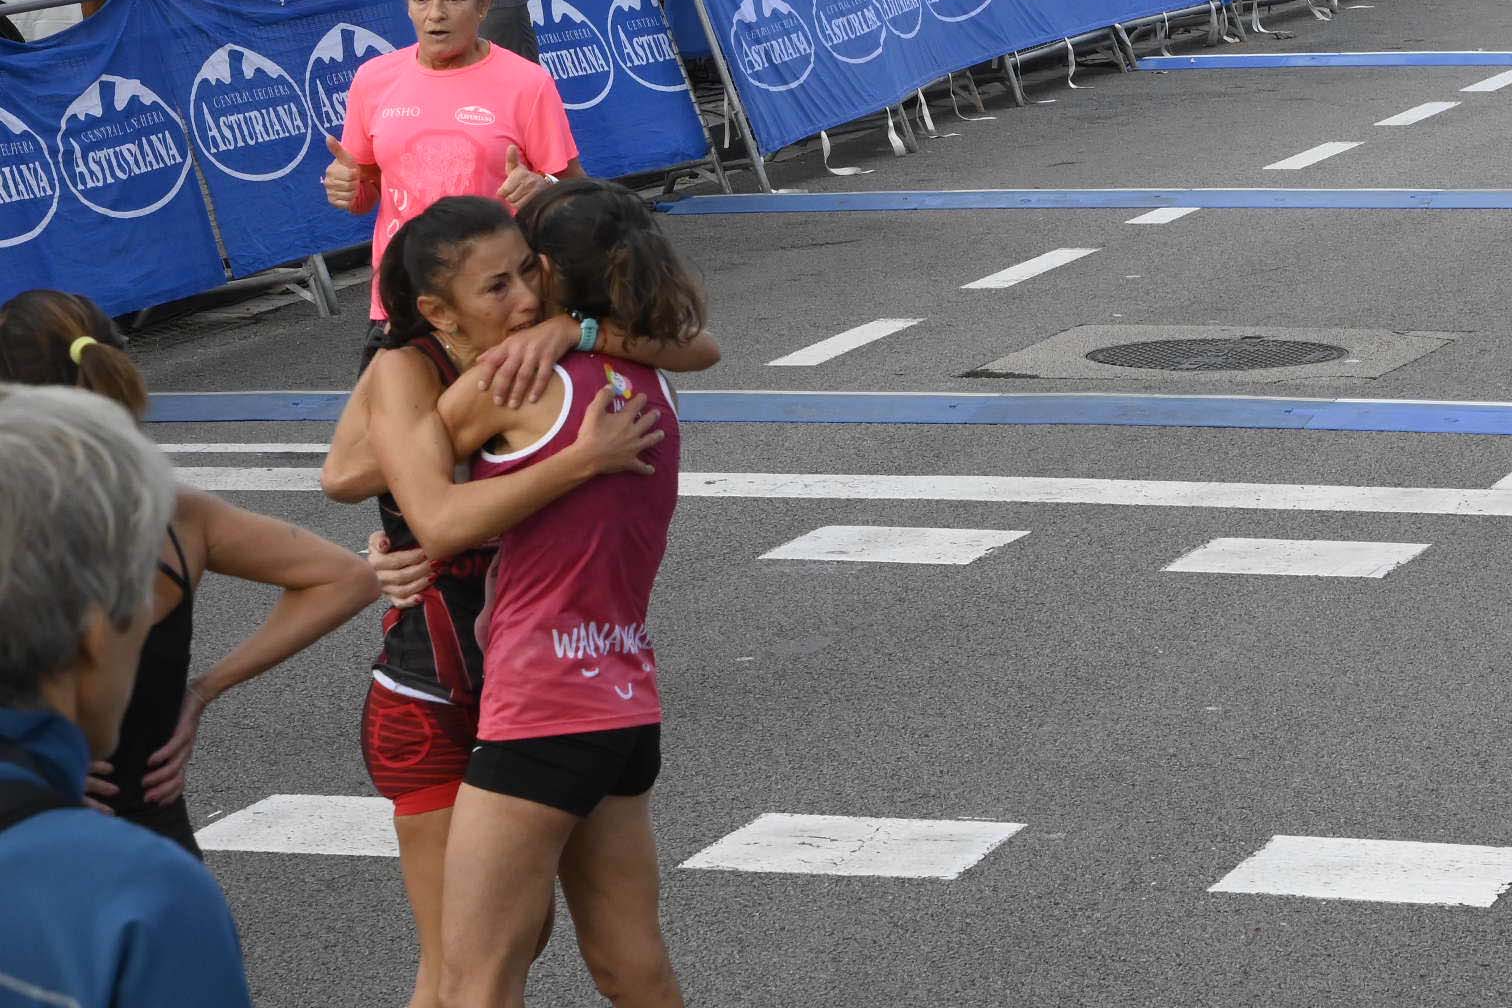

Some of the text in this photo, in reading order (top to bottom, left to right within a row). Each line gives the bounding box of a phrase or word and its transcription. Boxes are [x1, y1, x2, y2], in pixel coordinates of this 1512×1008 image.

[202, 99, 306, 154] ASTURIANA
[382, 106, 421, 119] OYSHO
[70, 131, 183, 192] ASTURIANA
